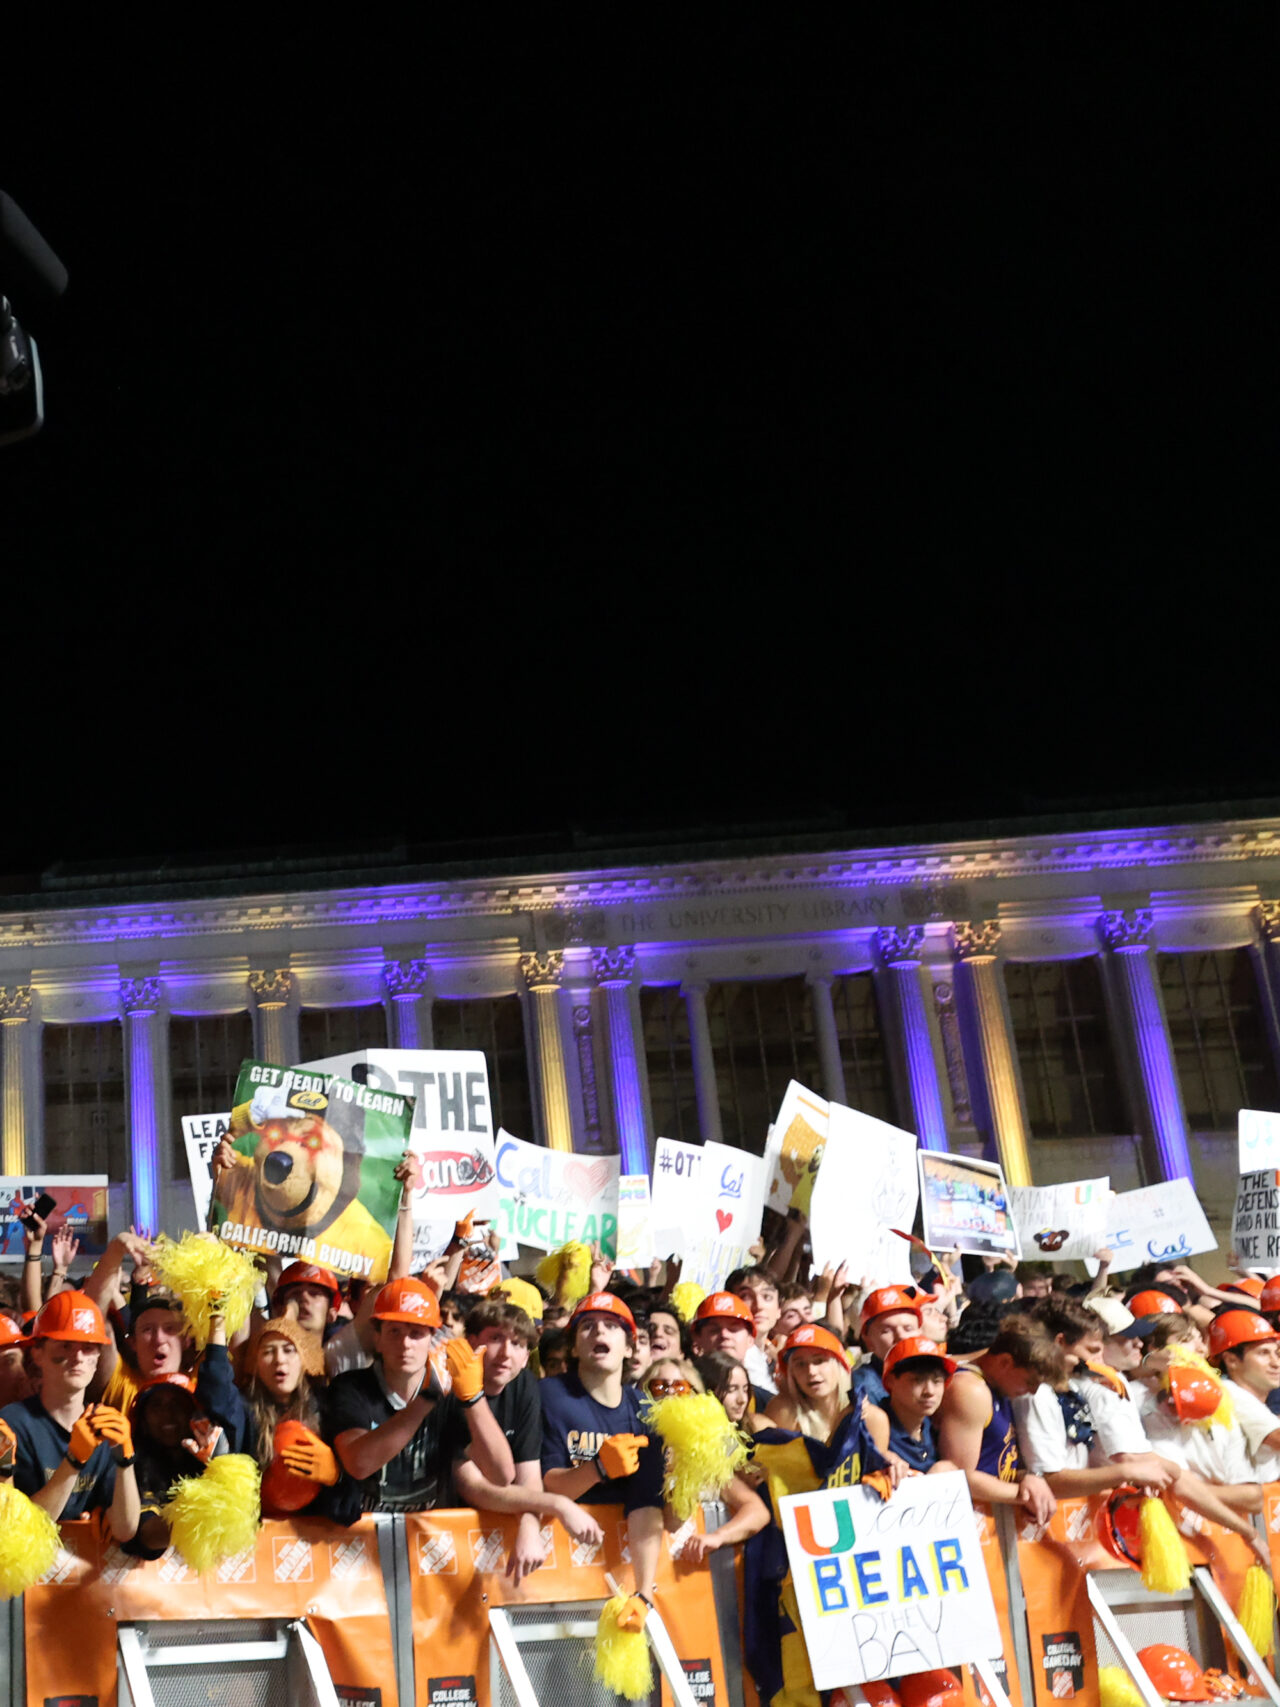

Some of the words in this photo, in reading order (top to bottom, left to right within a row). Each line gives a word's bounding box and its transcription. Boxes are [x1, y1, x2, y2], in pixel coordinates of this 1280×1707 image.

[621, 914, 655, 932] THE
[669, 903, 791, 929] UNIVERSITY
[803, 896, 889, 918] LIBRARY
[250, 1066, 281, 1085] GET
[282, 1070, 340, 1094] READY
[335, 1082, 354, 1104] TO
[356, 1084, 405, 1117] LEARN
[398, 1070, 488, 1133] THE
[496, 1142, 552, 1199] Cal
[718, 1163, 745, 1199] Cal
[1241, 1172, 1269, 1191] THE
[221, 1221, 317, 1259] CALIFORNIA
[319, 1243, 375, 1276] BUDDY
[1147, 1232, 1193, 1262] Cal
[794, 1499, 856, 1557] U
[274, 1538, 312, 1582] HOME
[808, 1538, 969, 1618] BEAR
[852, 1599, 945, 1683] BAY
[432, 1689, 470, 1702] COLLEGE
